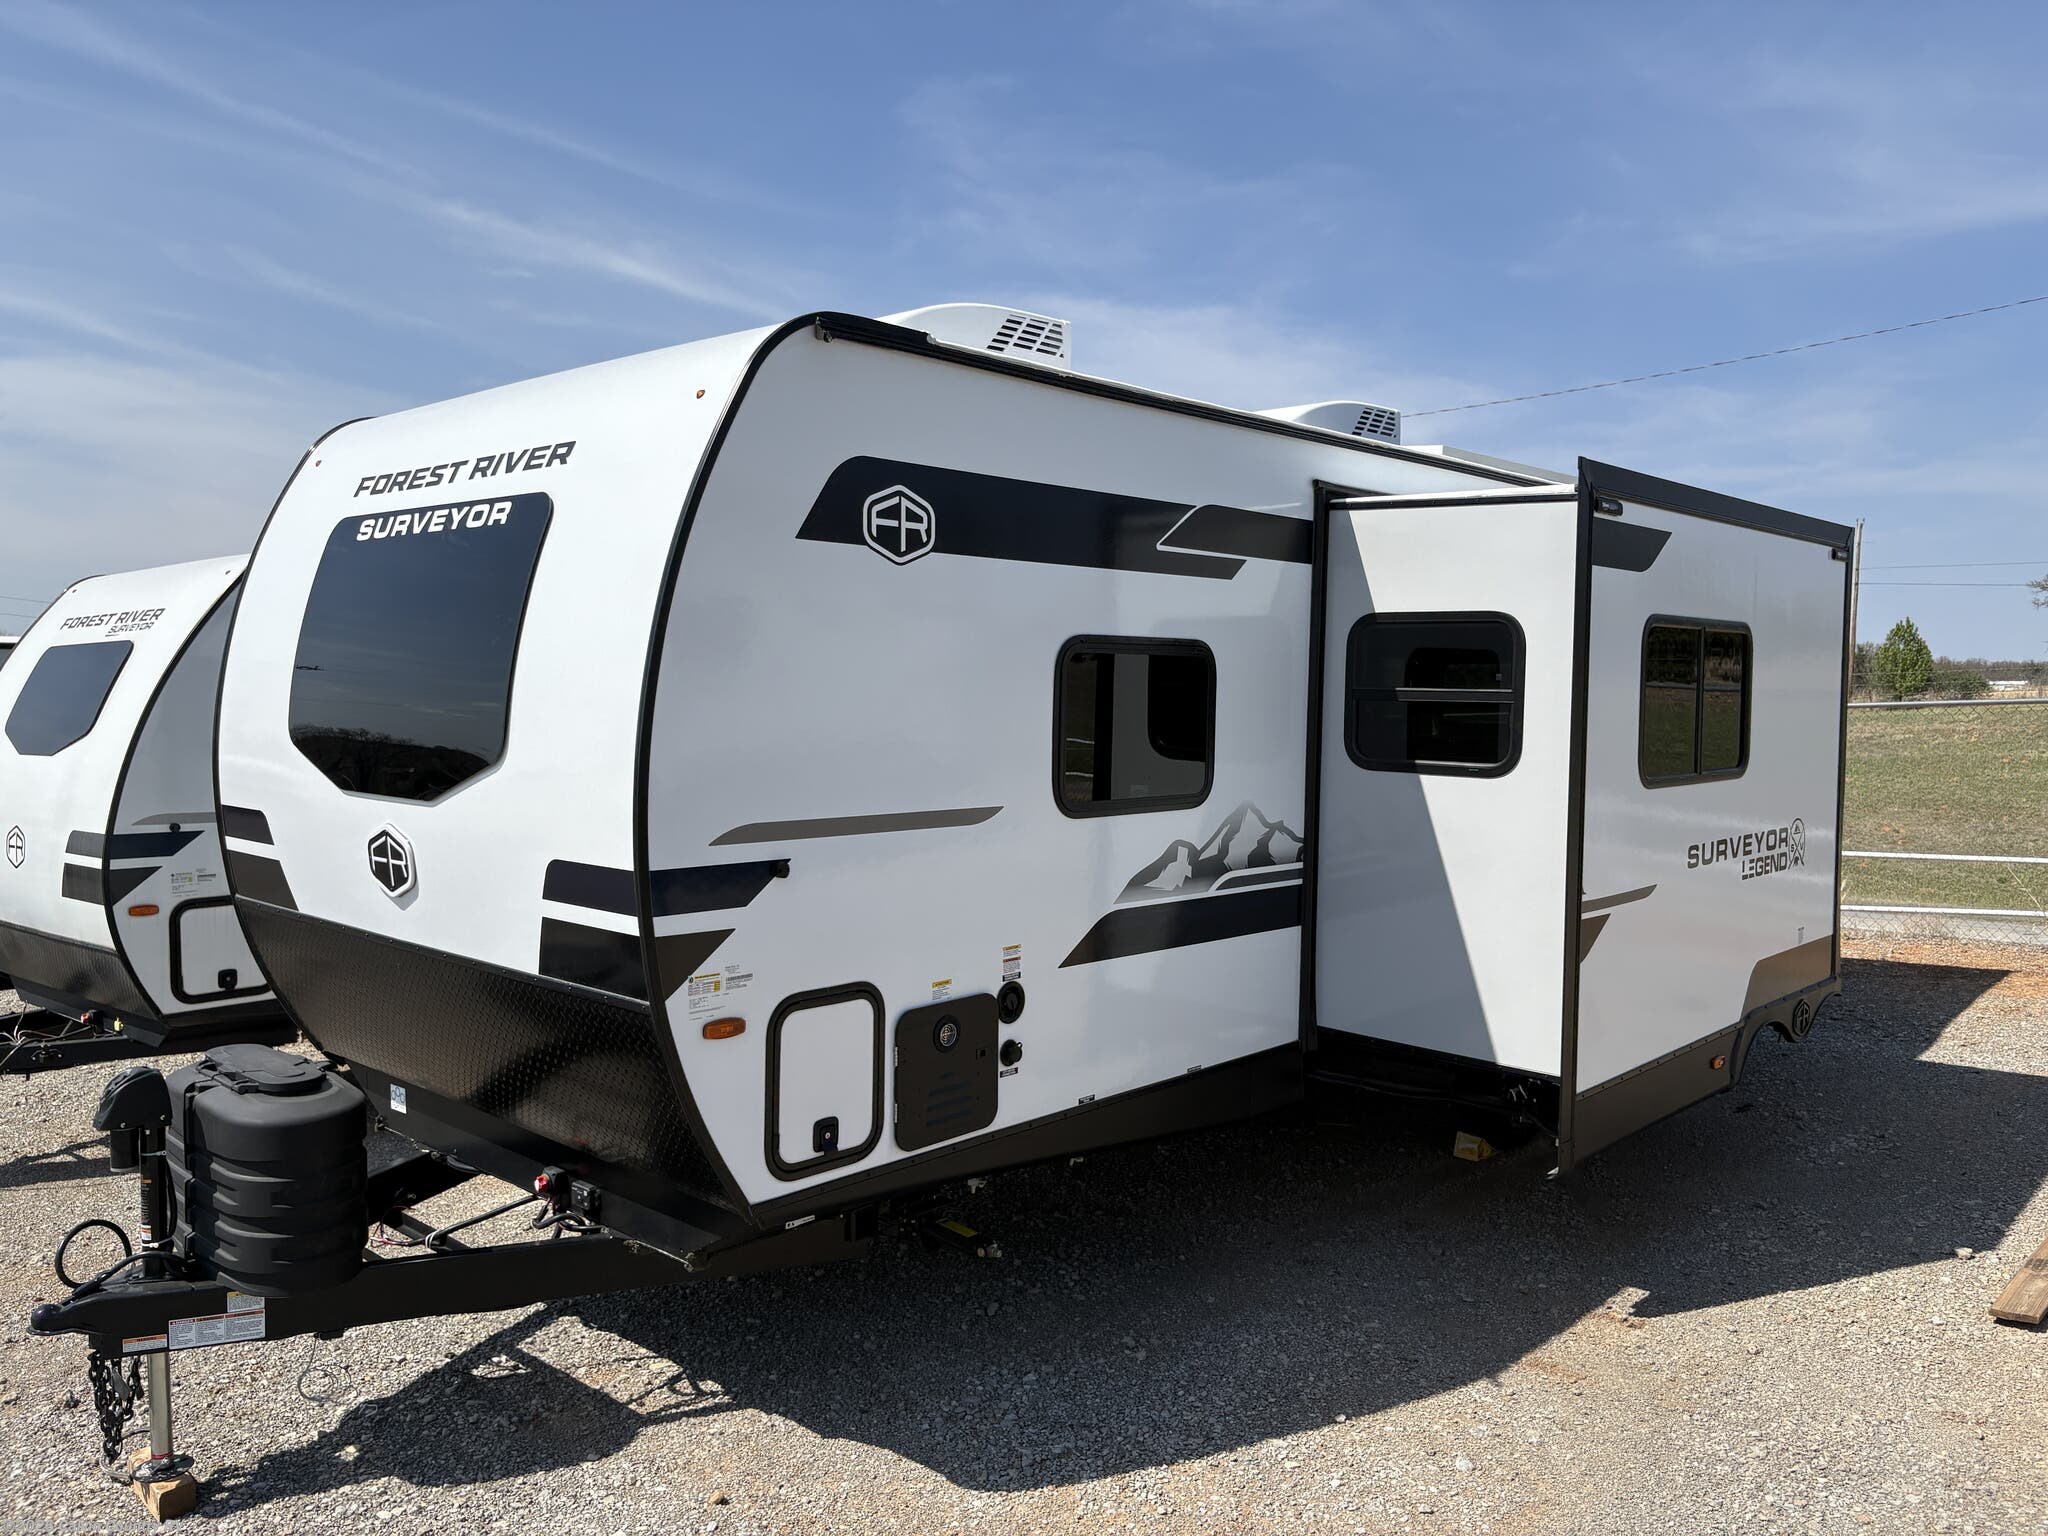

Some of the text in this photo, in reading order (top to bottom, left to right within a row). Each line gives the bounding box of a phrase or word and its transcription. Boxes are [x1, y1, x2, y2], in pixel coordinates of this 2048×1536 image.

[353, 440, 577, 498] FOREST RIVER
[356, 501, 513, 541] SURVEYOR
[60, 607, 166, 630] FOREST RIVER
[107, 621, 155, 634] SURVEYOR
[1687, 826, 1789, 869] SURVEYOR
[1741, 852, 1788, 880] LEGEND
